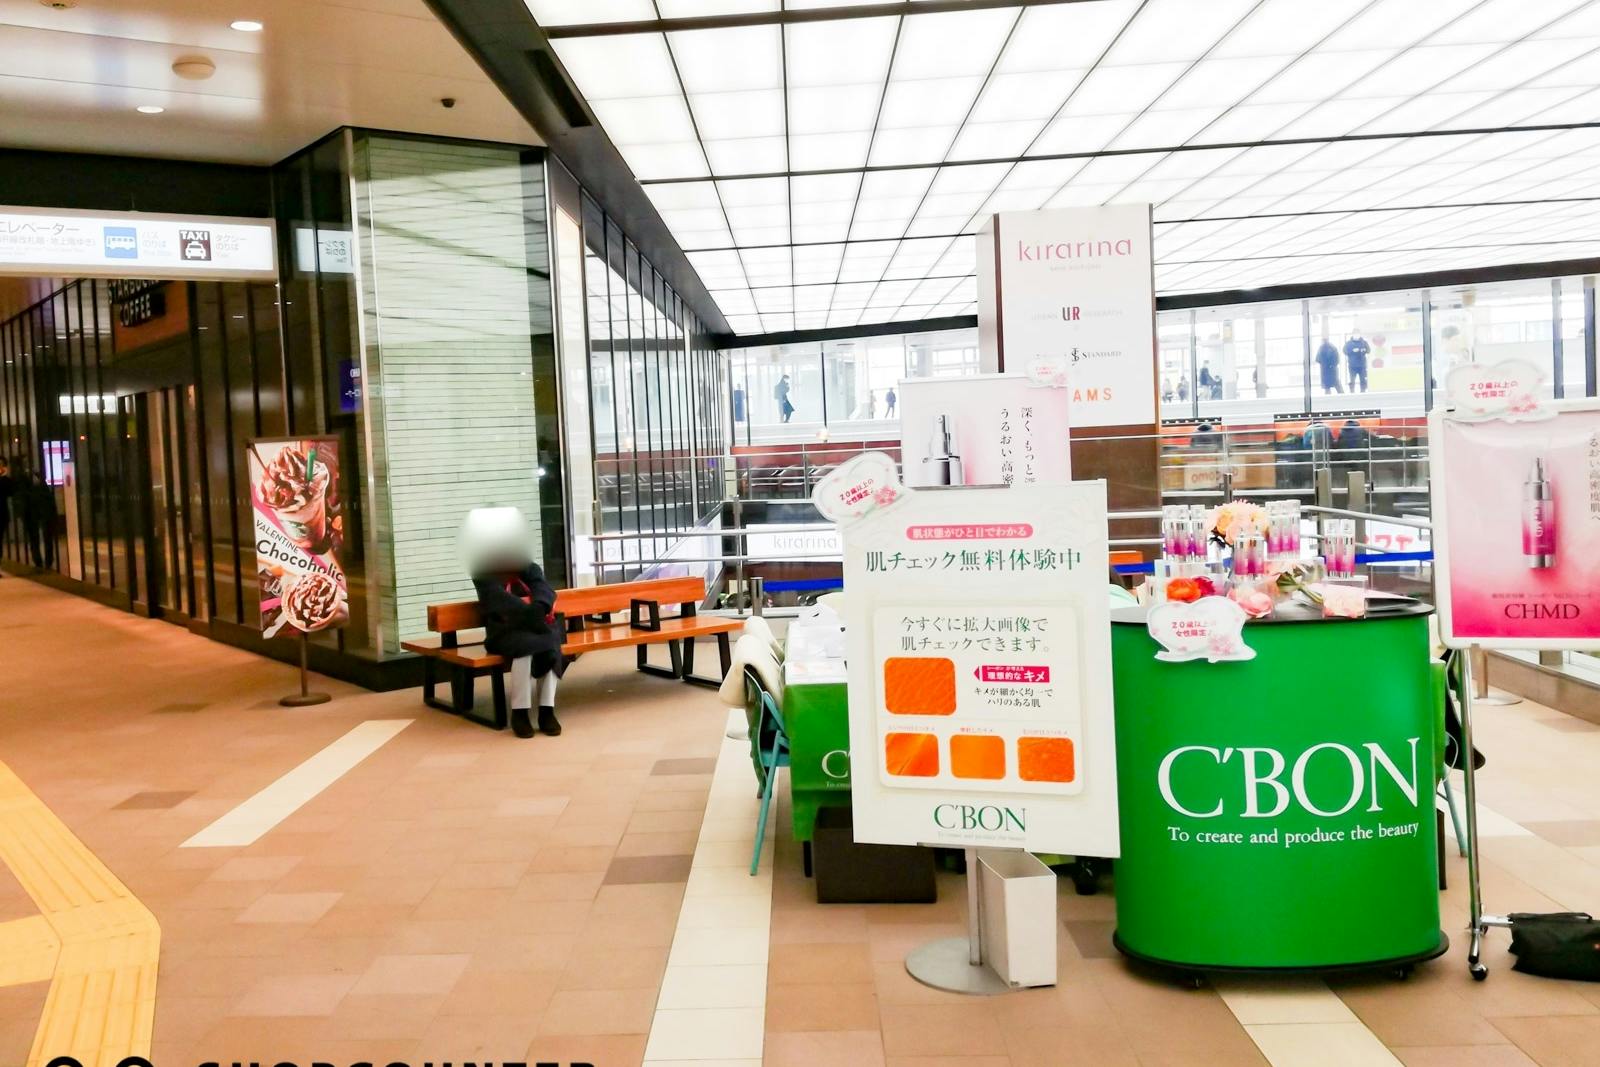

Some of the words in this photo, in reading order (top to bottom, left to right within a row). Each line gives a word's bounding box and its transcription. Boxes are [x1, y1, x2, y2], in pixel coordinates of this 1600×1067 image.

[180, 230, 209, 241] TAXI
[1018, 239, 1132, 262] kirarina
[1061, 306, 1081, 321] UR
[256, 519, 299, 553] VALENTINE
[256, 540, 344, 582] Chocoholic
[865, 548, 1081, 572] 肌チェック無料体験中
[1504, 603, 1580, 619] CHMD
[901, 616, 1050, 632] 今すぐに拡大画像で
[901, 636, 1050, 653] 肌チェックできます。
[987, 698, 1041, 708] ハリのある肌
[1157, 737, 1421, 818] C'BON
[933, 803, 1026, 833] C'BON
[1167, 826, 1190, 842] To
[1196, 829, 1243, 844] create
[1249, 828, 1278, 844] and
[1285, 827, 1345, 848] produce
[1350, 824, 1374, 841] the
[1378, 822, 1420, 838] beauty
